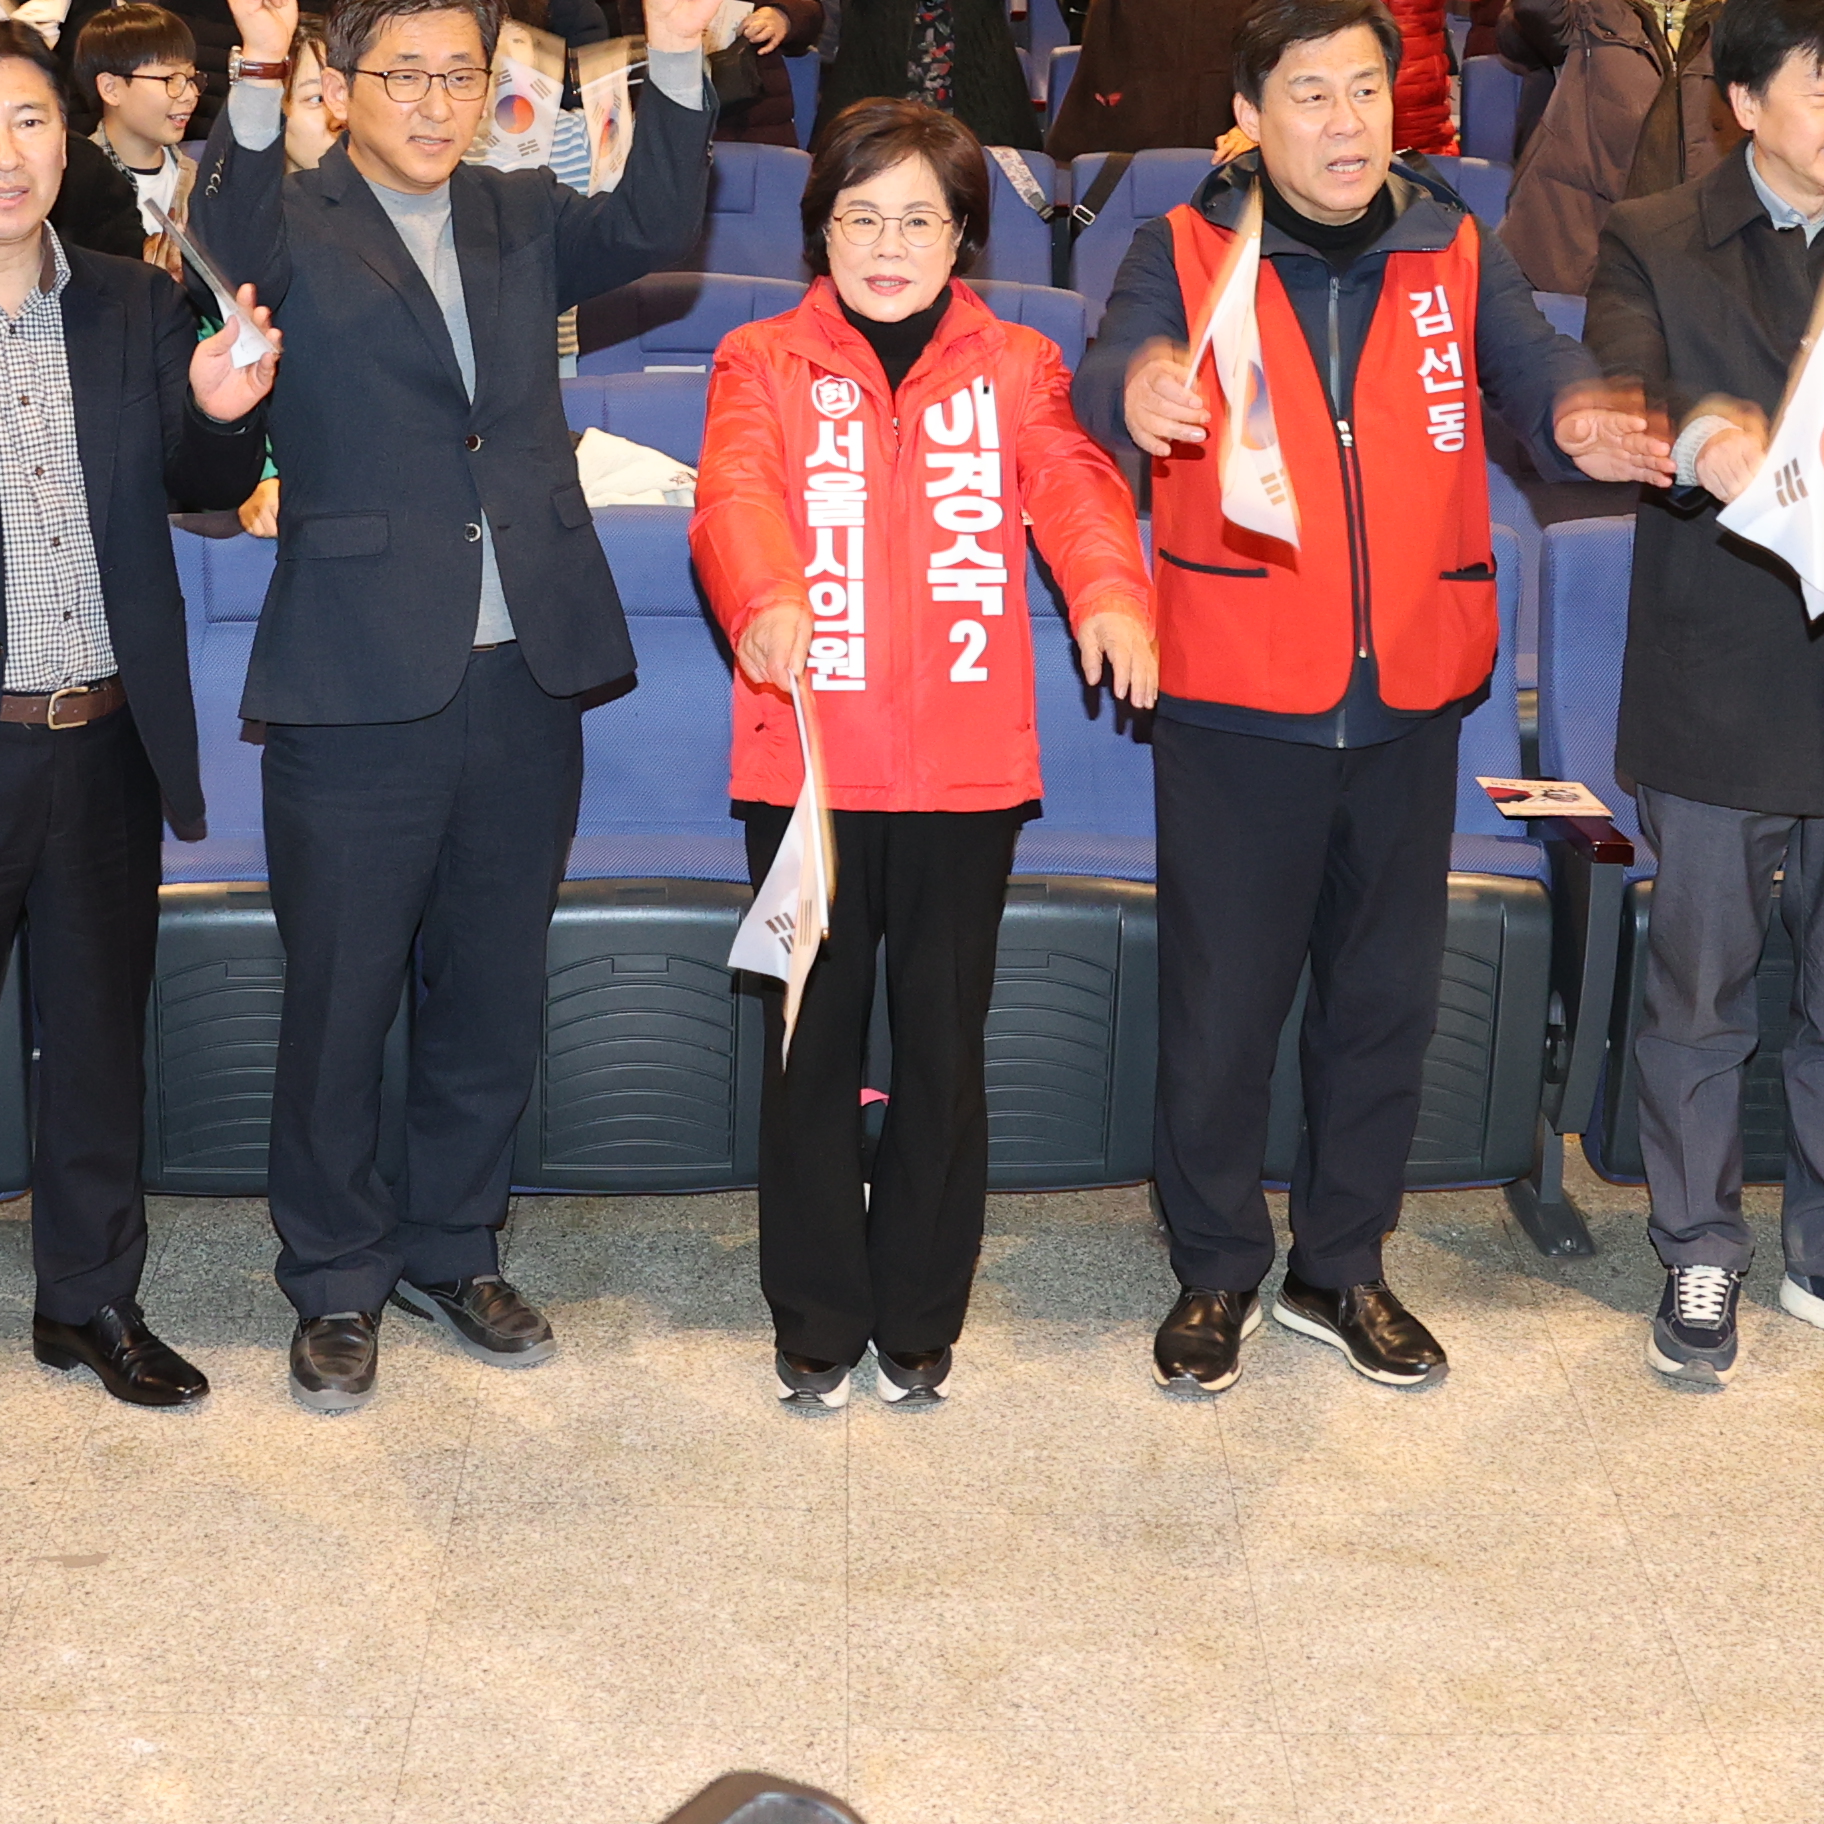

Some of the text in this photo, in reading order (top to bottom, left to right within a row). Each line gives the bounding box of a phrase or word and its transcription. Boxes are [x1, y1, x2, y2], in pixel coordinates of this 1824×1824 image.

[1408, 284, 1466, 453] 김선동
[803, 420, 868, 691] 서울시의원
[924, 374, 1008, 683] 이경숙 2
